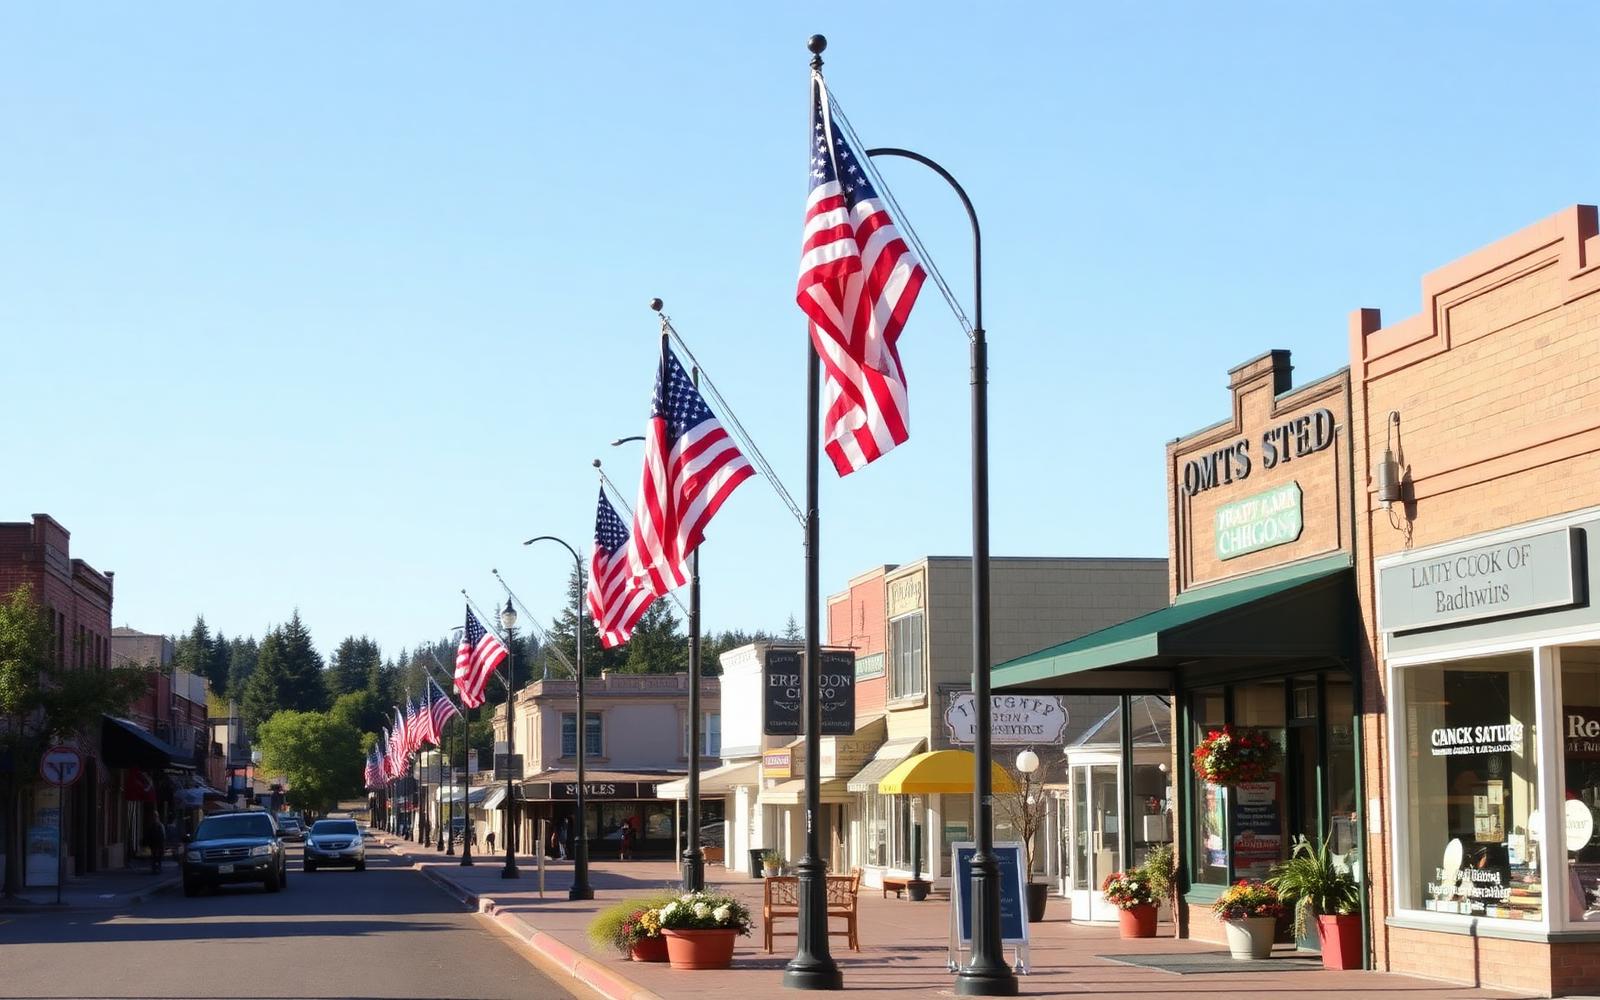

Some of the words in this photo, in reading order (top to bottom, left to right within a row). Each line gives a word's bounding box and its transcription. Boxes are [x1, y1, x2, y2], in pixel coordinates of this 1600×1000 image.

[1184, 438, 1251, 496] OMTS
[1263, 408, 1335, 469] STED
[1507, 544, 1531, 570] OF
